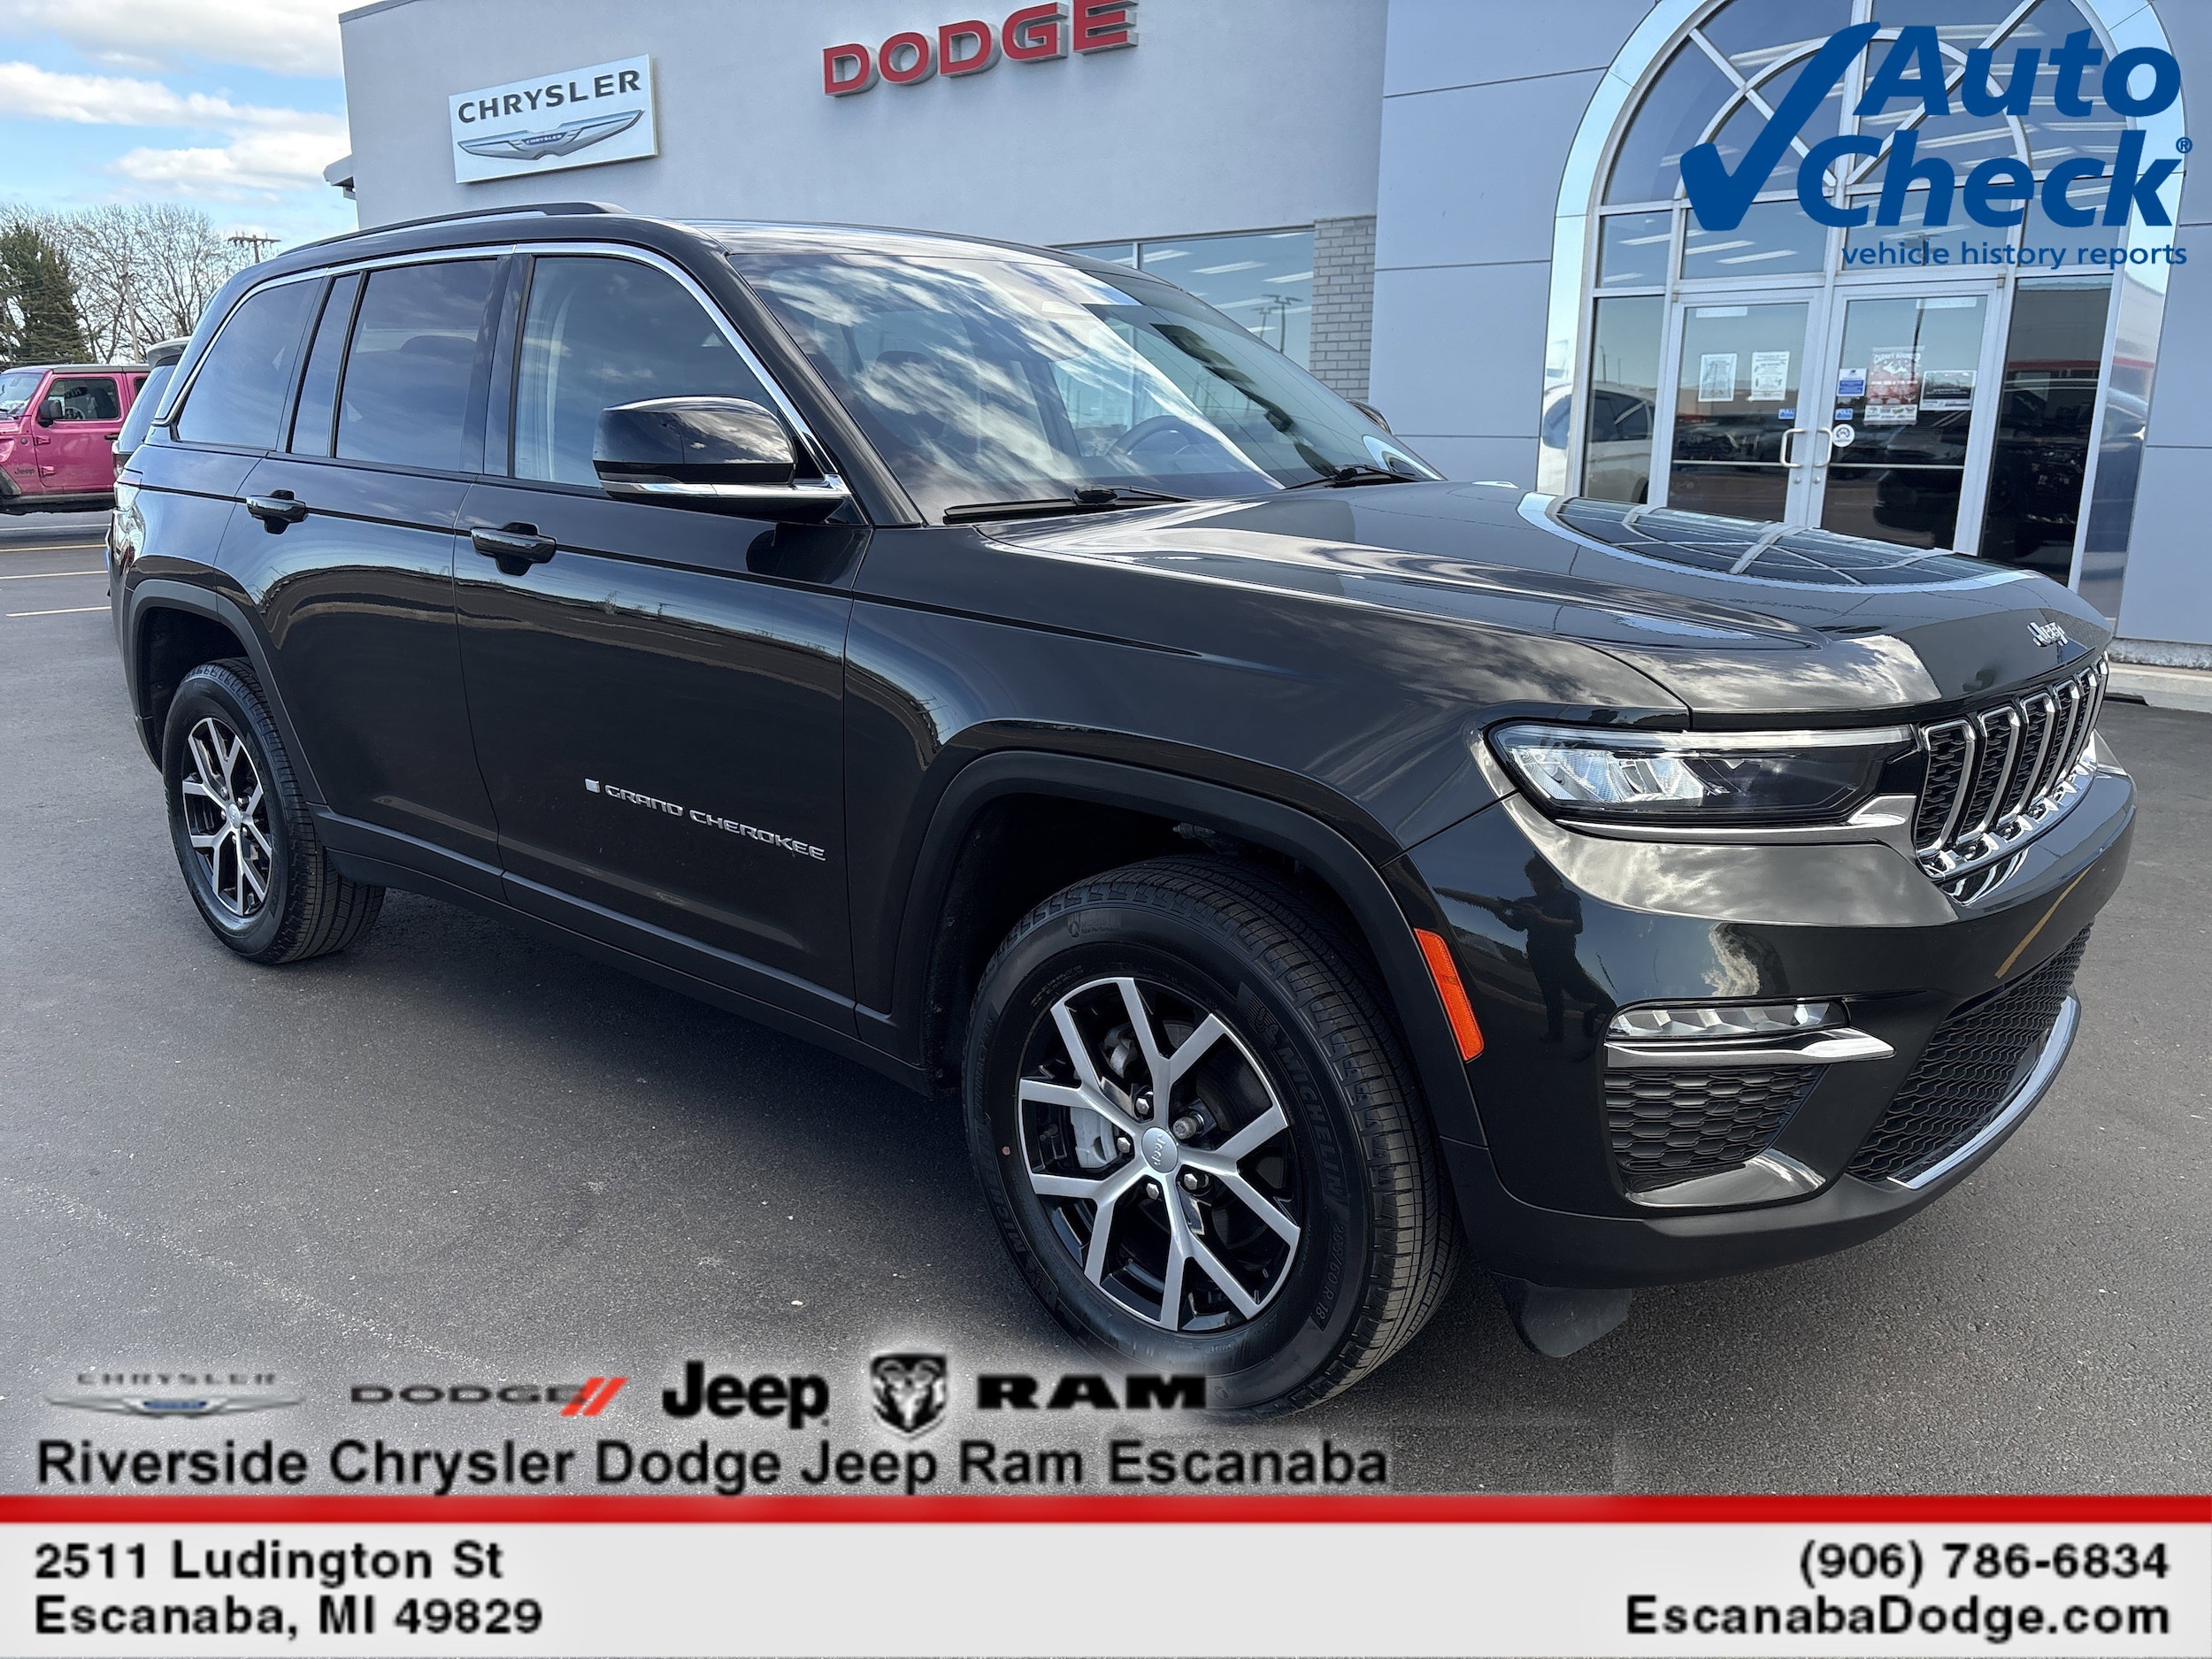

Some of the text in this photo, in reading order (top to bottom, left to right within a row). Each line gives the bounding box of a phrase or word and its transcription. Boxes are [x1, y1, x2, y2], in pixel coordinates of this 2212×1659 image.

[822, 0, 1138, 96] DODGE
[458, 70, 641, 123] CHRYSLER
[604, 785, 826, 861] GRAND CHEROKEE
[1150, 1133, 1166, 1166] Jeep
[1276, 1046, 1347, 1200] MICHELIN
[1315, 1302, 1329, 1320] 18
[1322, 1285, 1335, 1301] R
